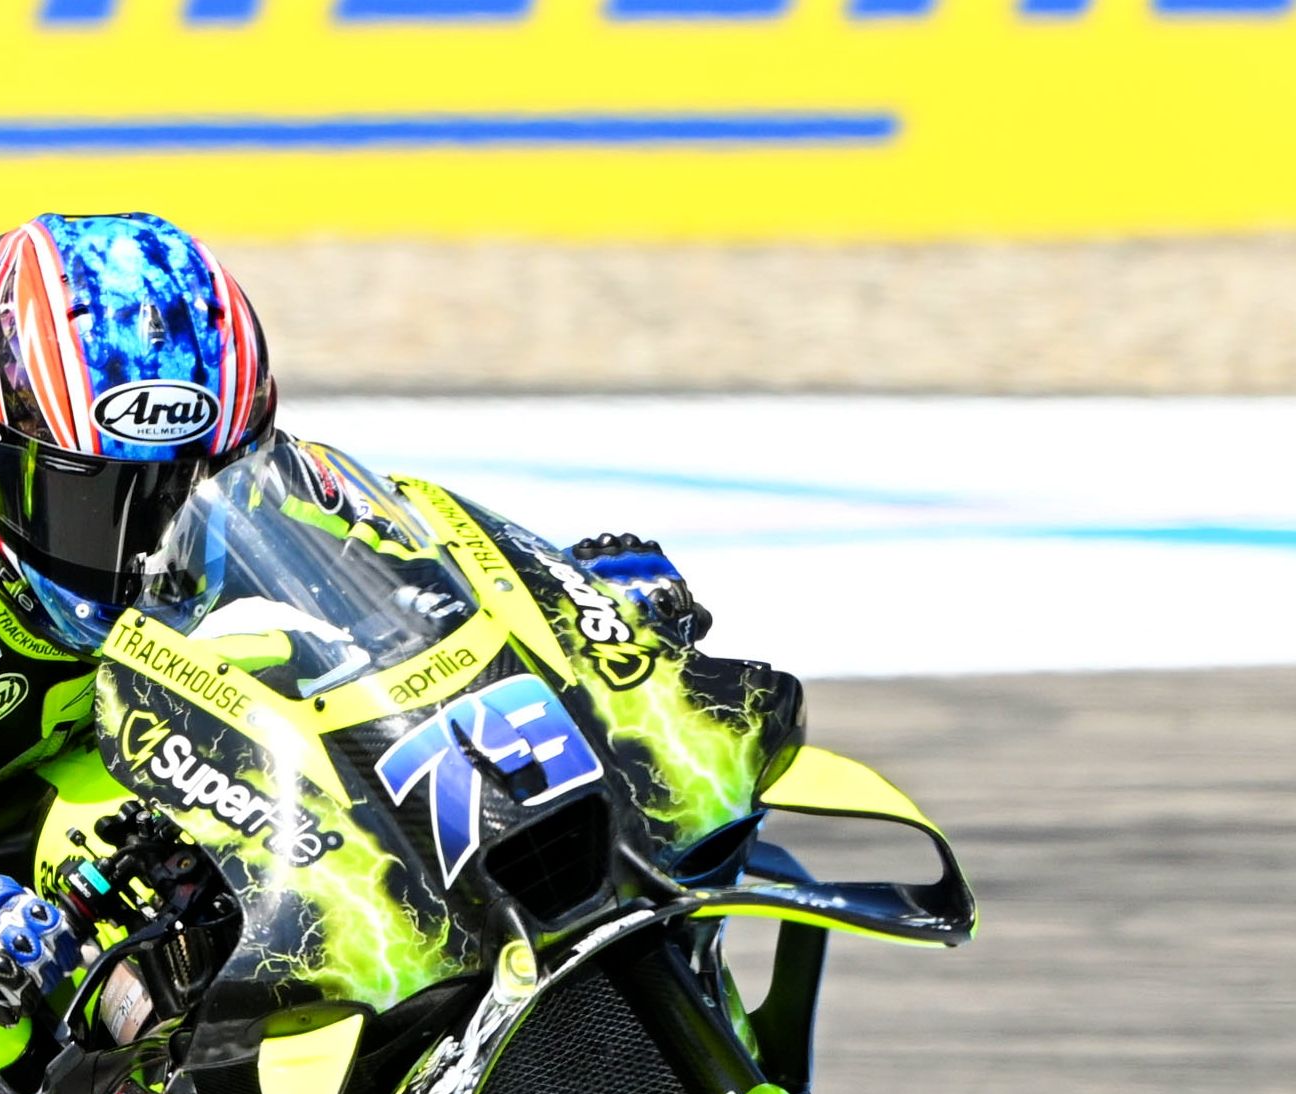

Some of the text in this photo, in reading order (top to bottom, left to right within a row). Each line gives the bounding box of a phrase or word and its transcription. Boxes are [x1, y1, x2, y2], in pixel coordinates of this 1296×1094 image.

[102, 390, 208, 427] Arai
[114, 624, 252, 718] TRACKHOUSE
[388, 646, 479, 704] aprilia
[373, 673, 605, 891] 79
